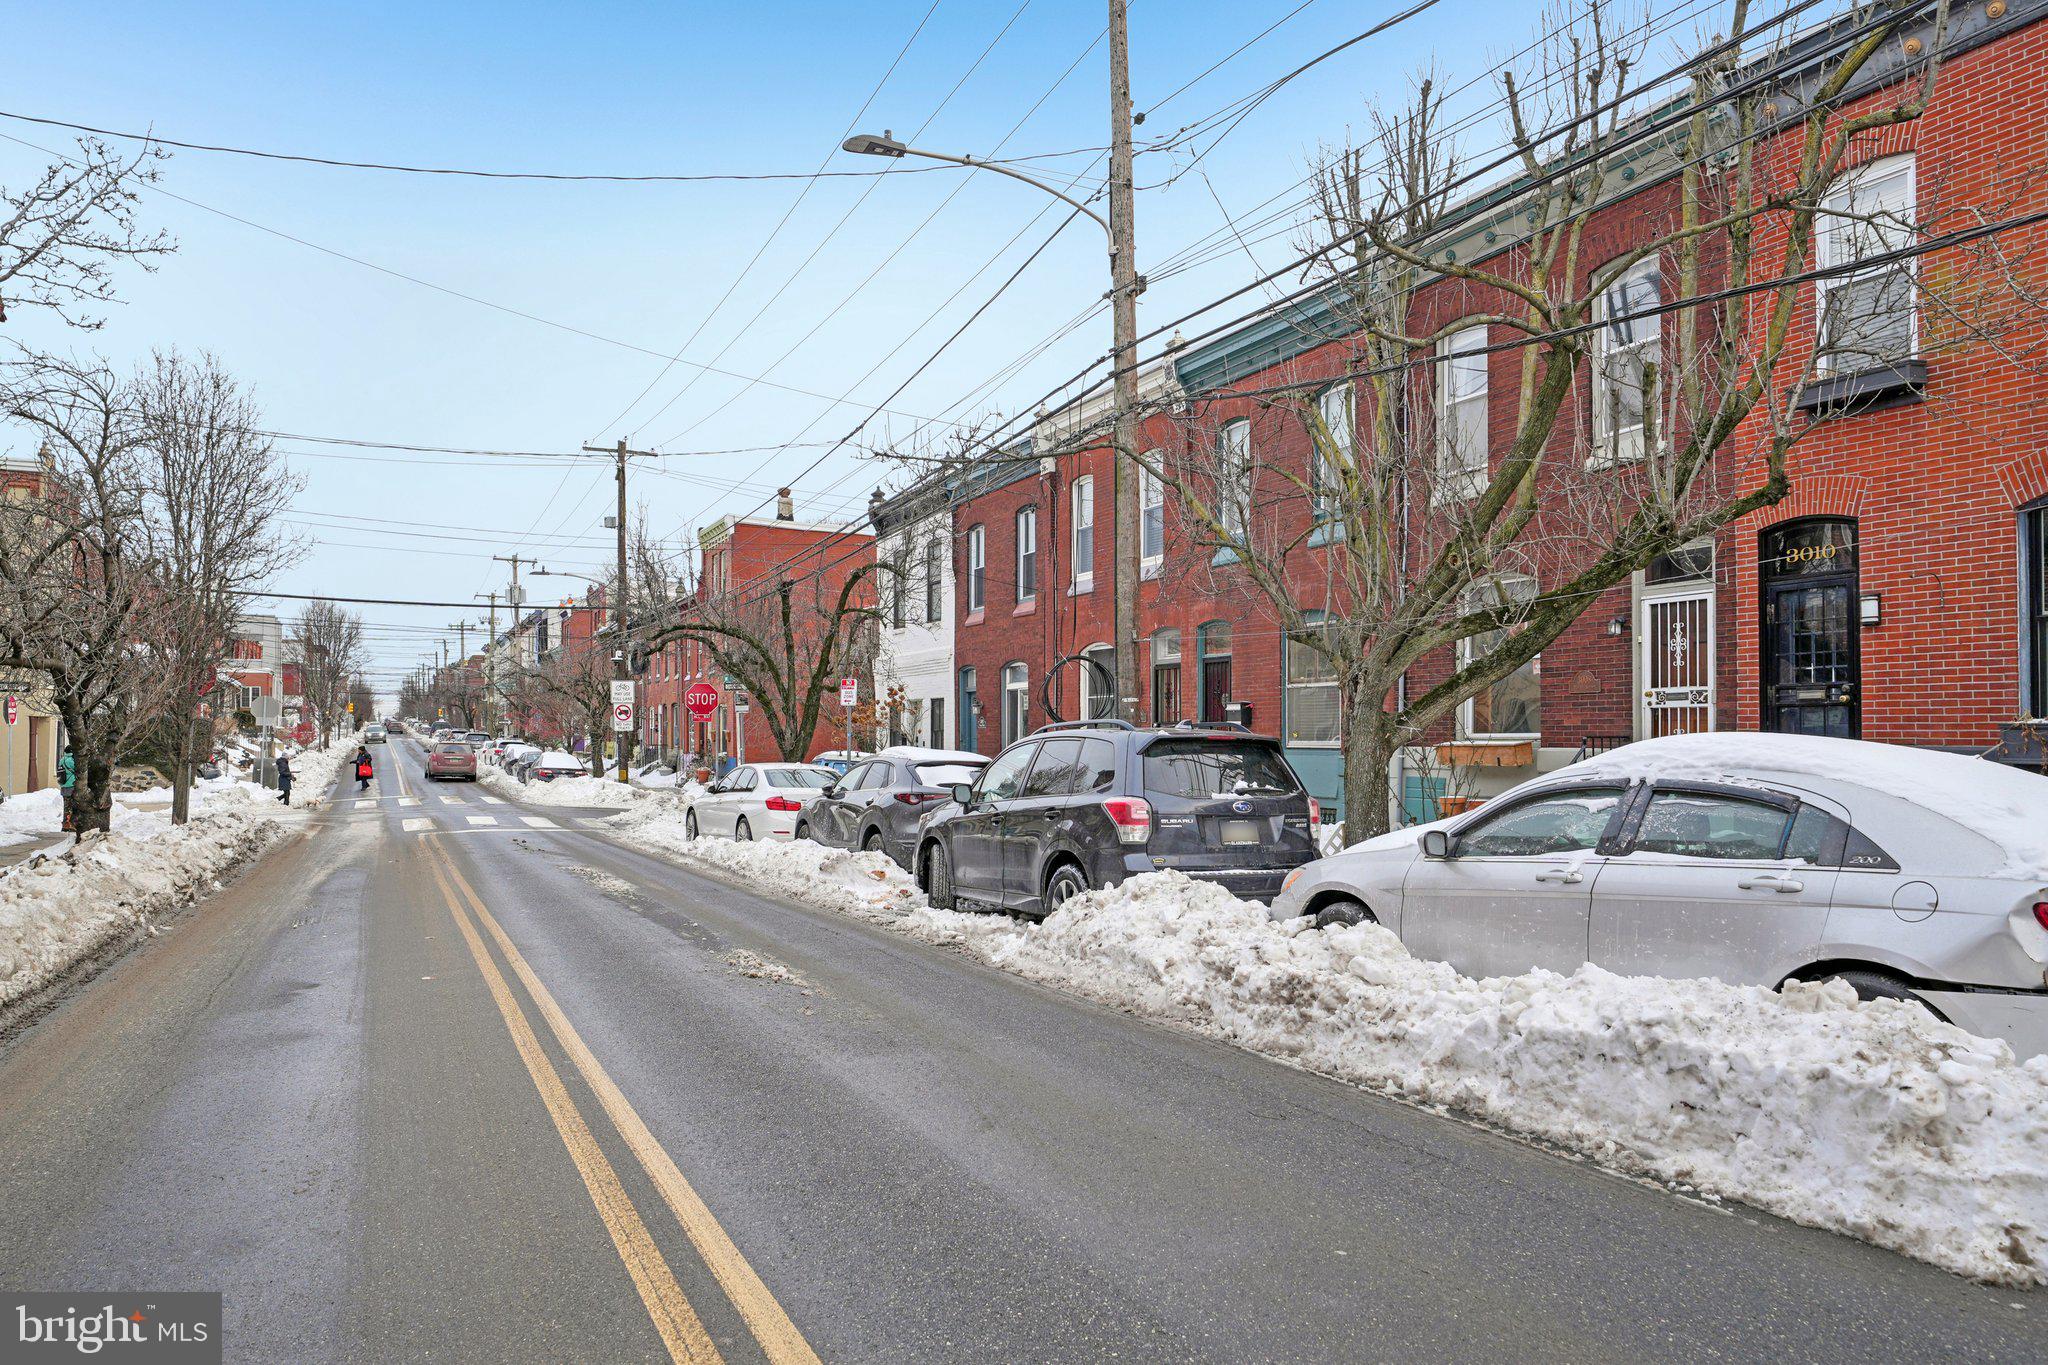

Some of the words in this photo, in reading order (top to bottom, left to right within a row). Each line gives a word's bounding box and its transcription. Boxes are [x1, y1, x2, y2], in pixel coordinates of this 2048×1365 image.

[1786, 543, 1836, 563] 3010
[688, 693, 716, 705] STOP
[1849, 856, 1882, 865] 200
